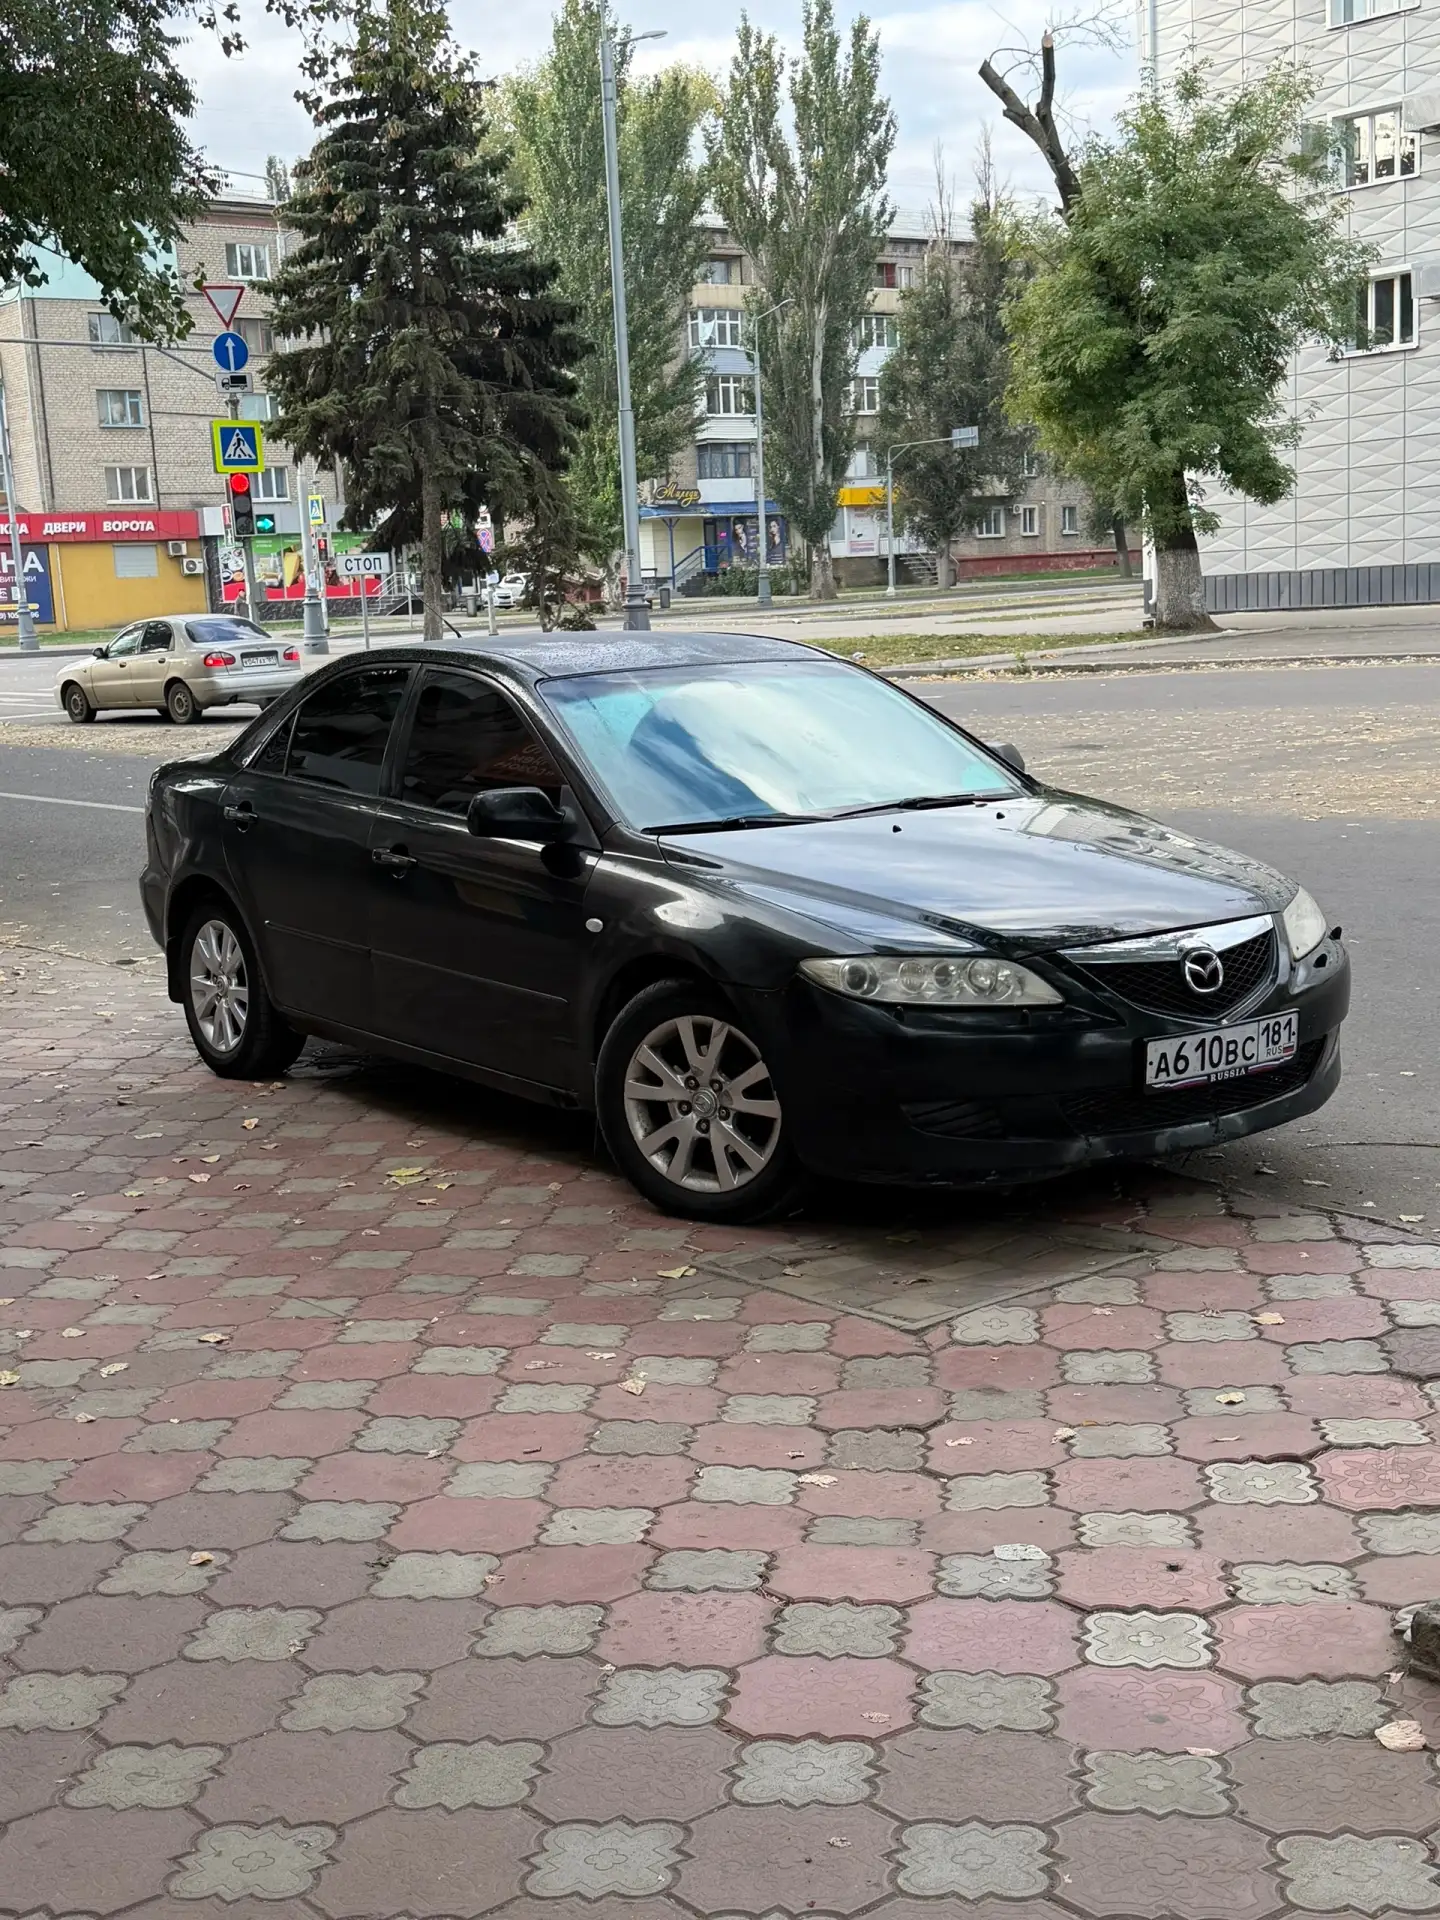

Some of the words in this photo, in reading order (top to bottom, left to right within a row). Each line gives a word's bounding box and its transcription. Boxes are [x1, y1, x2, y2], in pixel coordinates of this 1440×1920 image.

[43, 522, 86, 535] ДВЕРИ
[103, 521, 155, 532] ВОРОТА
[345, 557, 382, 572] СТОП
[1154, 1035, 1256, 1079] А610ВС
[1261, 1017, 1293, 1047] 181
[1266, 1045, 1283, 1057] RUS
[1210, 1067, 1246, 1082] RUSSIA
